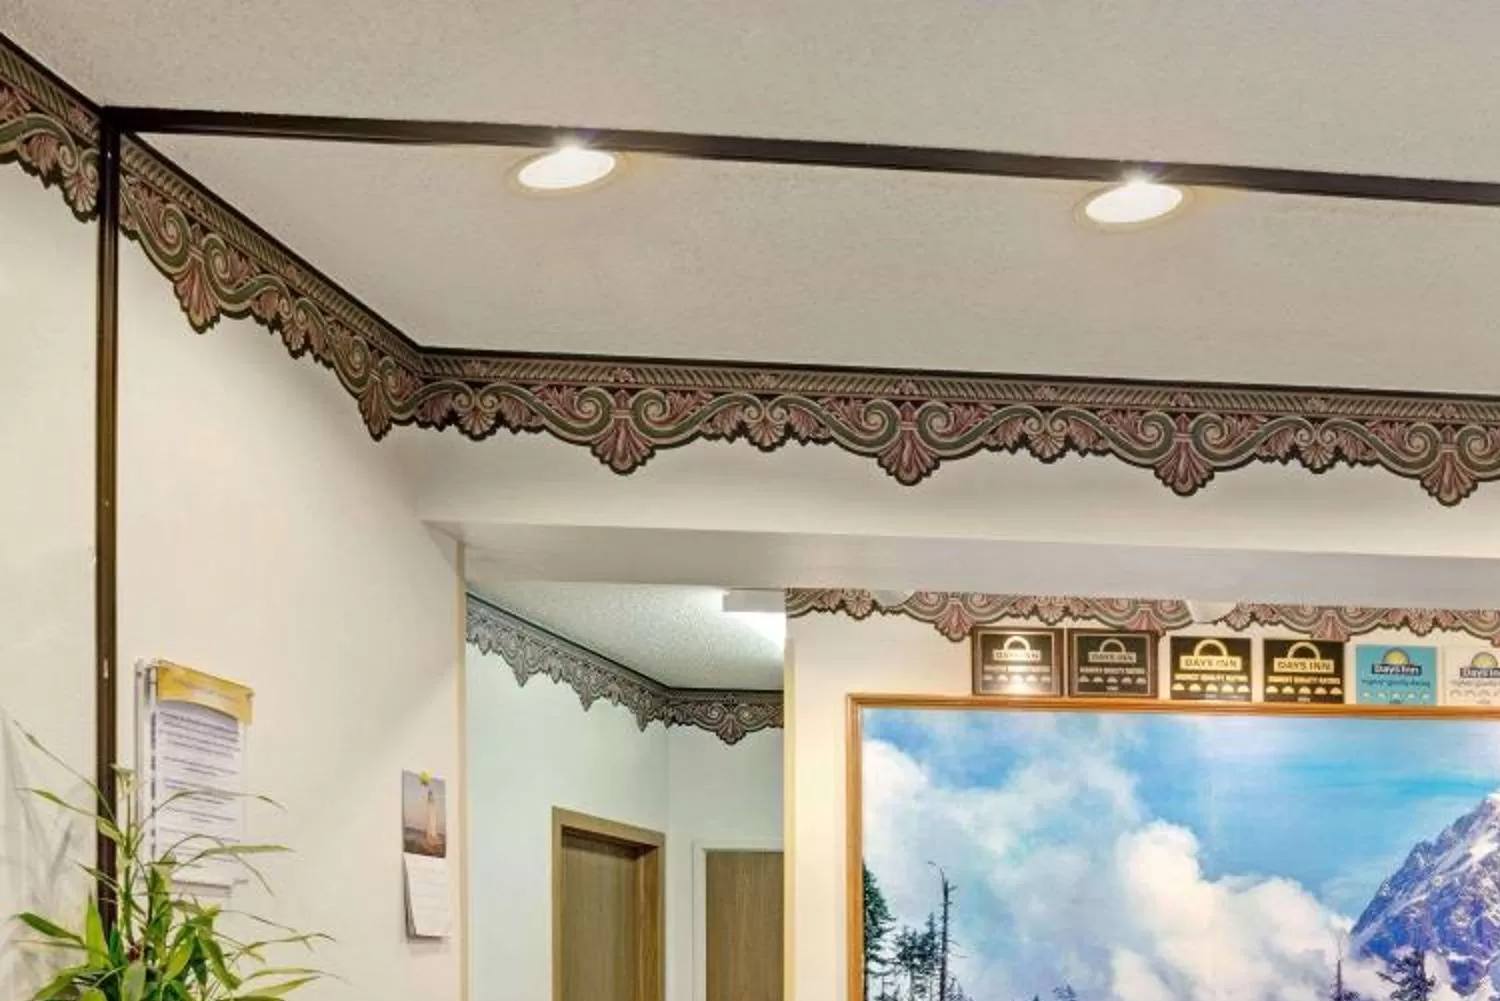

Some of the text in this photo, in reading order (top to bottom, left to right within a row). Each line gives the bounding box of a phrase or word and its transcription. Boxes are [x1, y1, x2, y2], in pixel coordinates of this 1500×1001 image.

[1184, 657, 1213, 667] DAYS
[1276, 660, 1332, 671] DAYS INN
